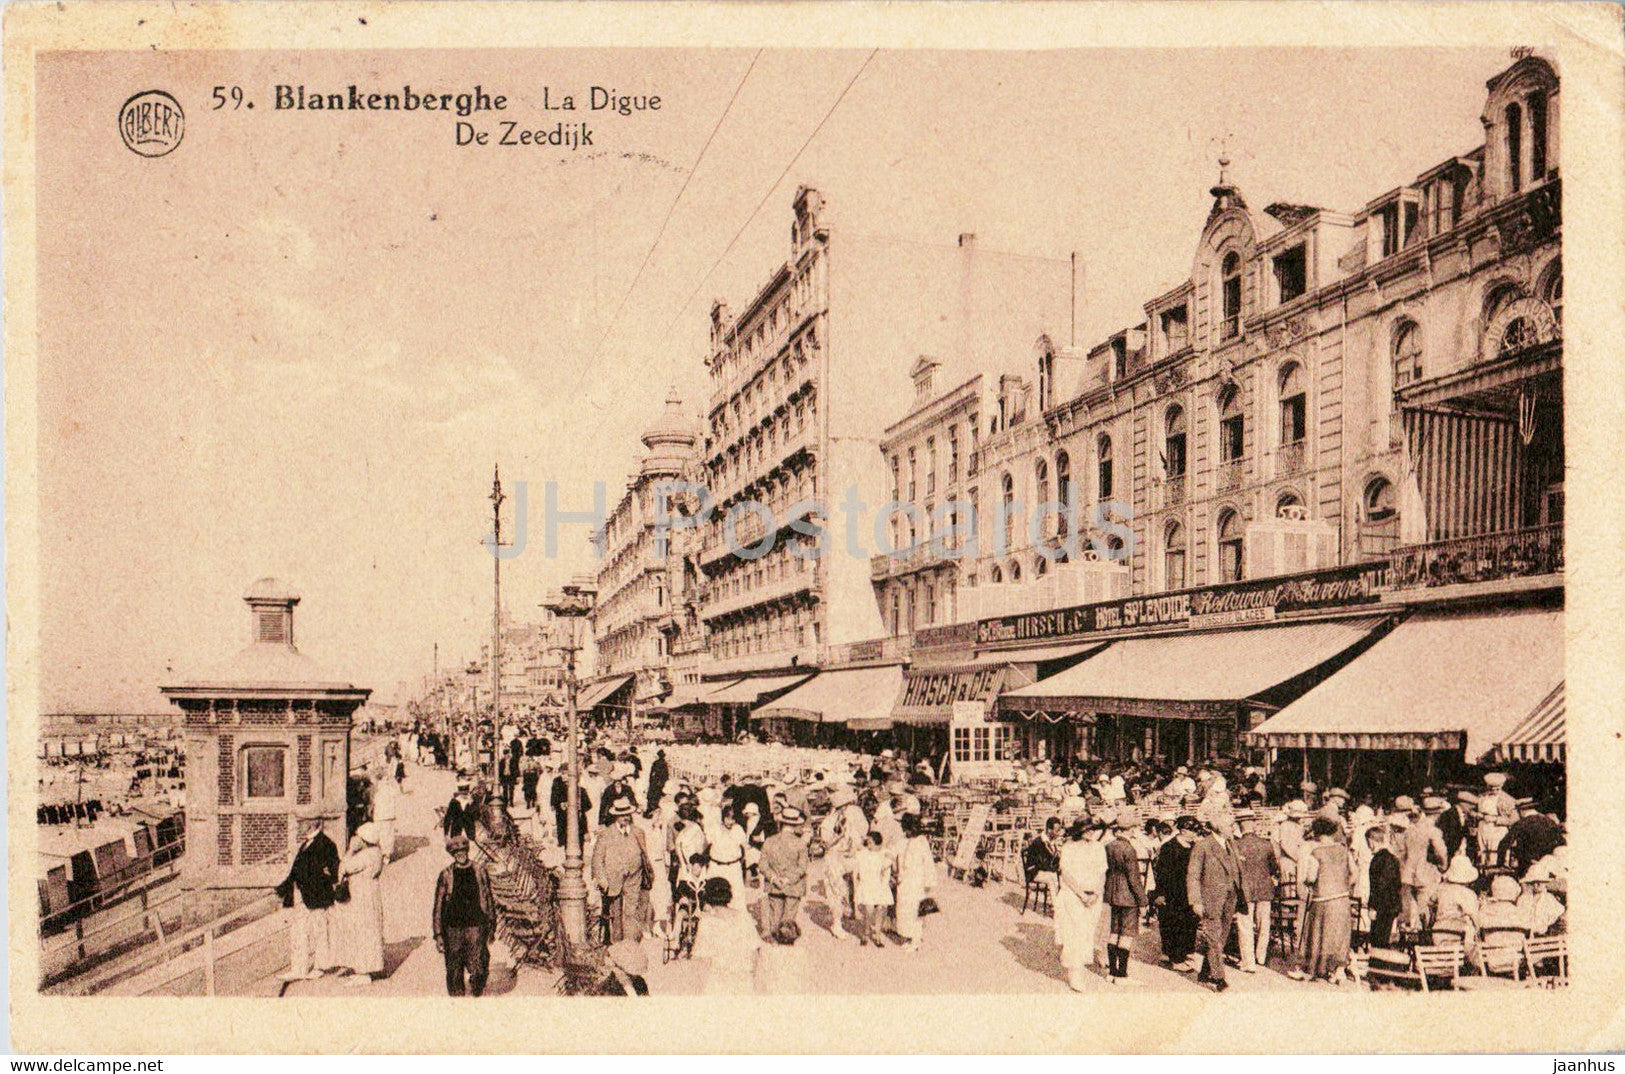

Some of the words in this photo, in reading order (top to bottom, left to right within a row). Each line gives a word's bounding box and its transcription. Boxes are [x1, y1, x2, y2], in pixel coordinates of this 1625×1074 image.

[1016, 611, 1065, 639] HIRSCH
[1123, 594, 1192, 626] SPLENDIDE
[1197, 583, 1284, 614] Restaurant
[902, 672, 959, 706] HIRSCH
